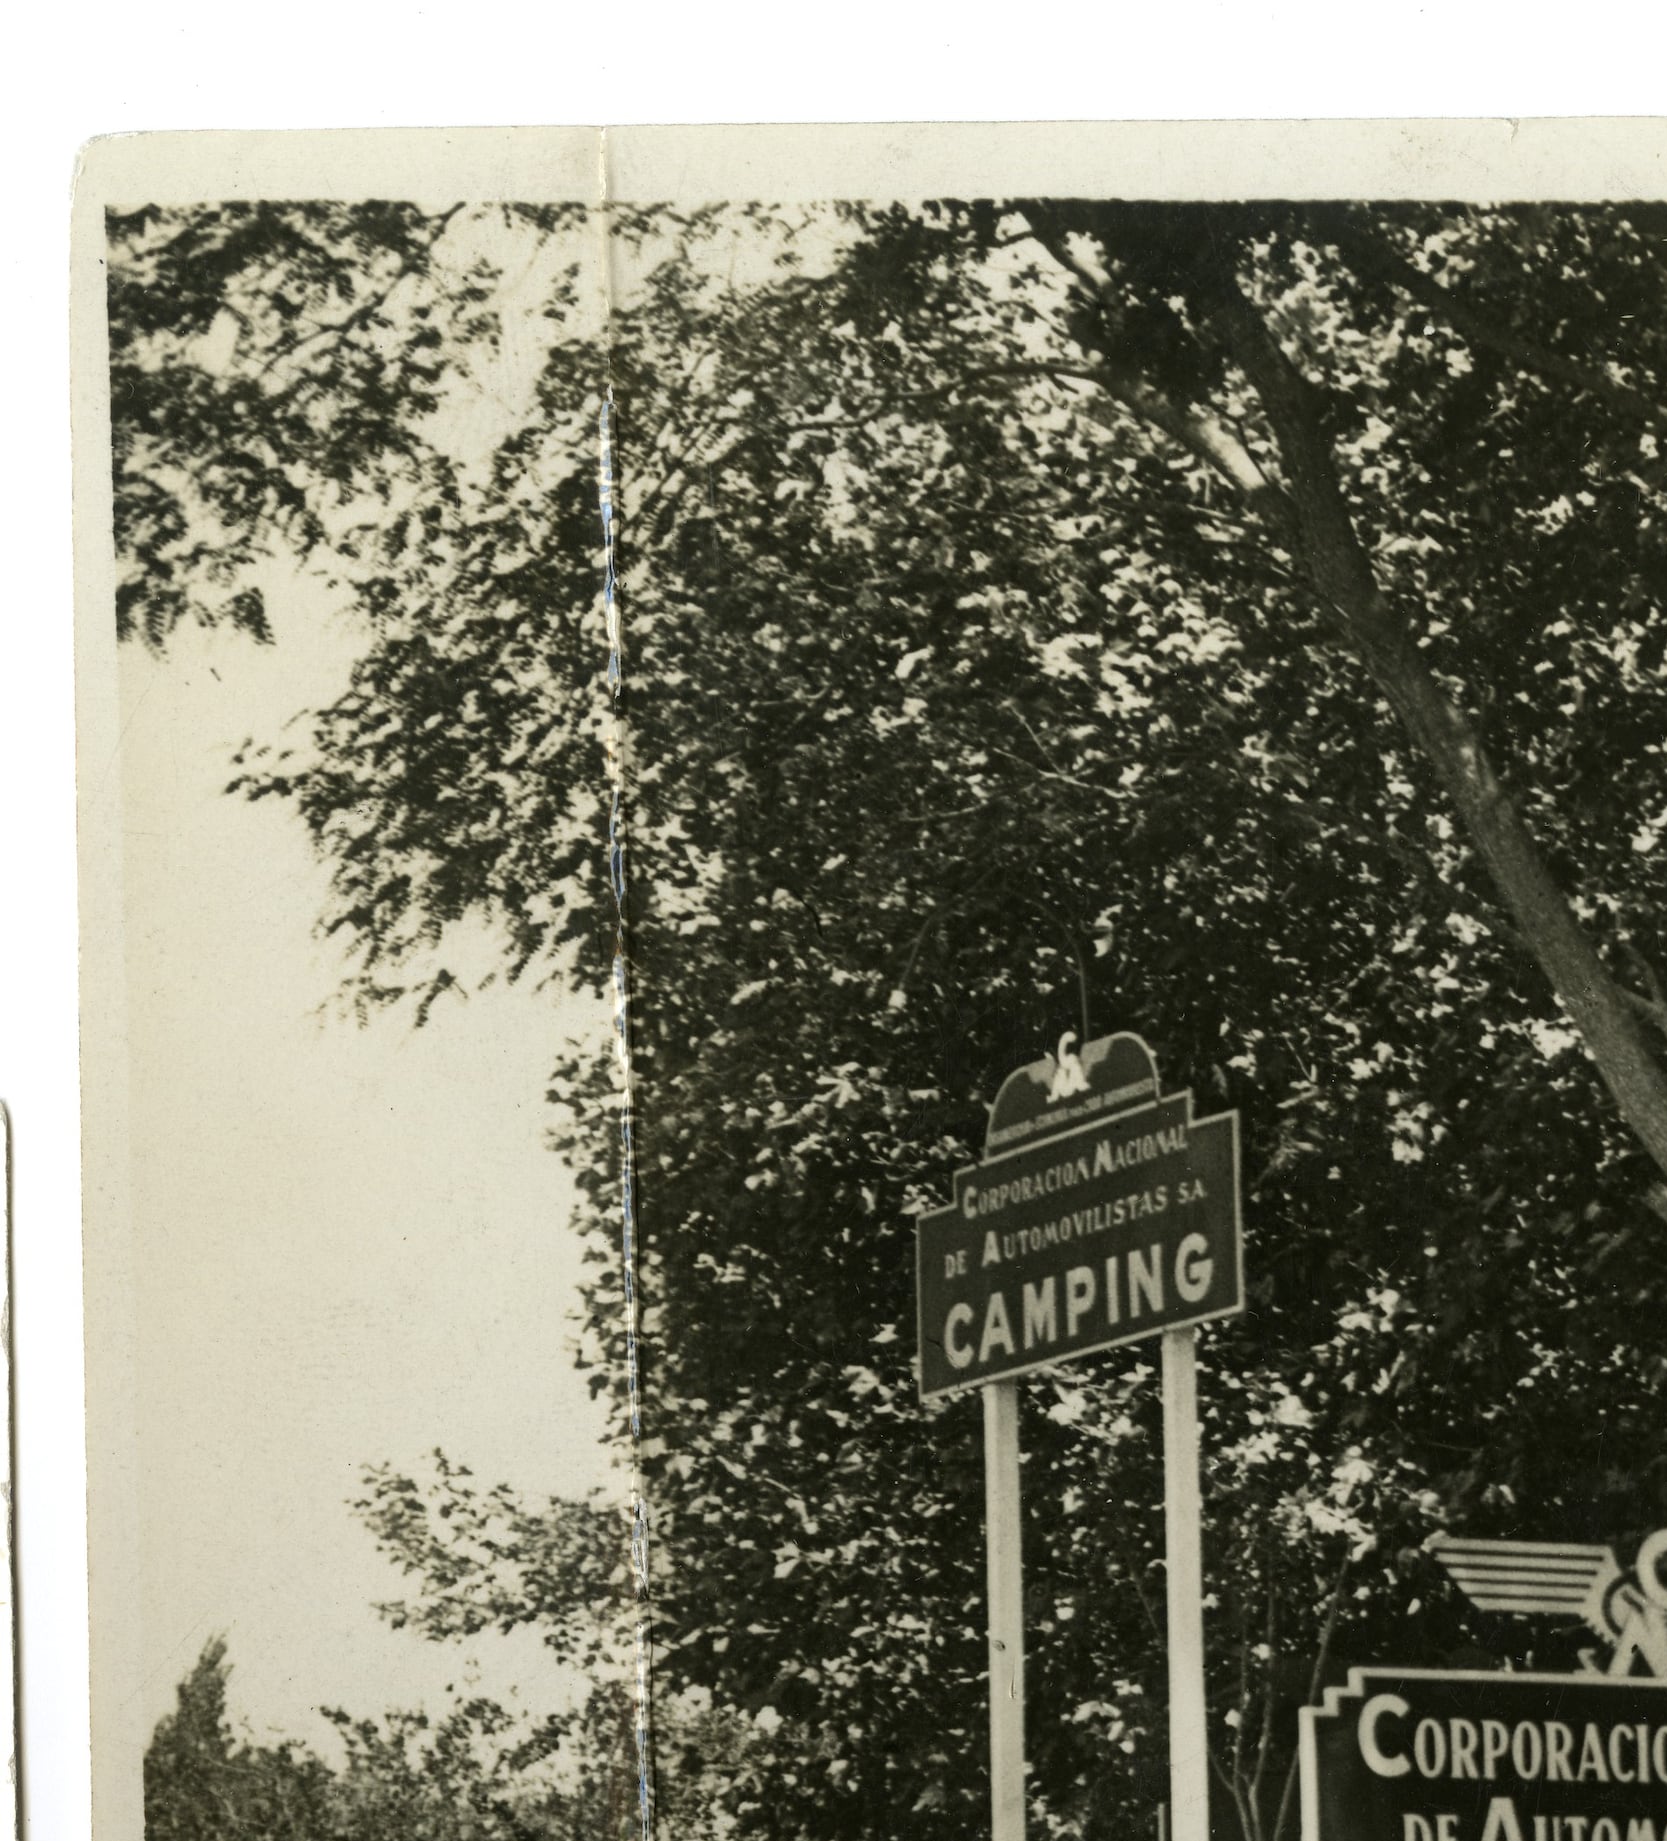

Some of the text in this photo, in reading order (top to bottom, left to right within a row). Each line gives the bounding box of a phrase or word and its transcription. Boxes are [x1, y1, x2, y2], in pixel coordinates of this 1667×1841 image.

[962, 1123, 1188, 1219] CORPORACION NACIONAL
[944, 1249, 967, 1279] DE
[981, 1185, 1168, 1267] AUTOMOVILISTAS
[944, 1232, 1214, 1369] CAMPING
